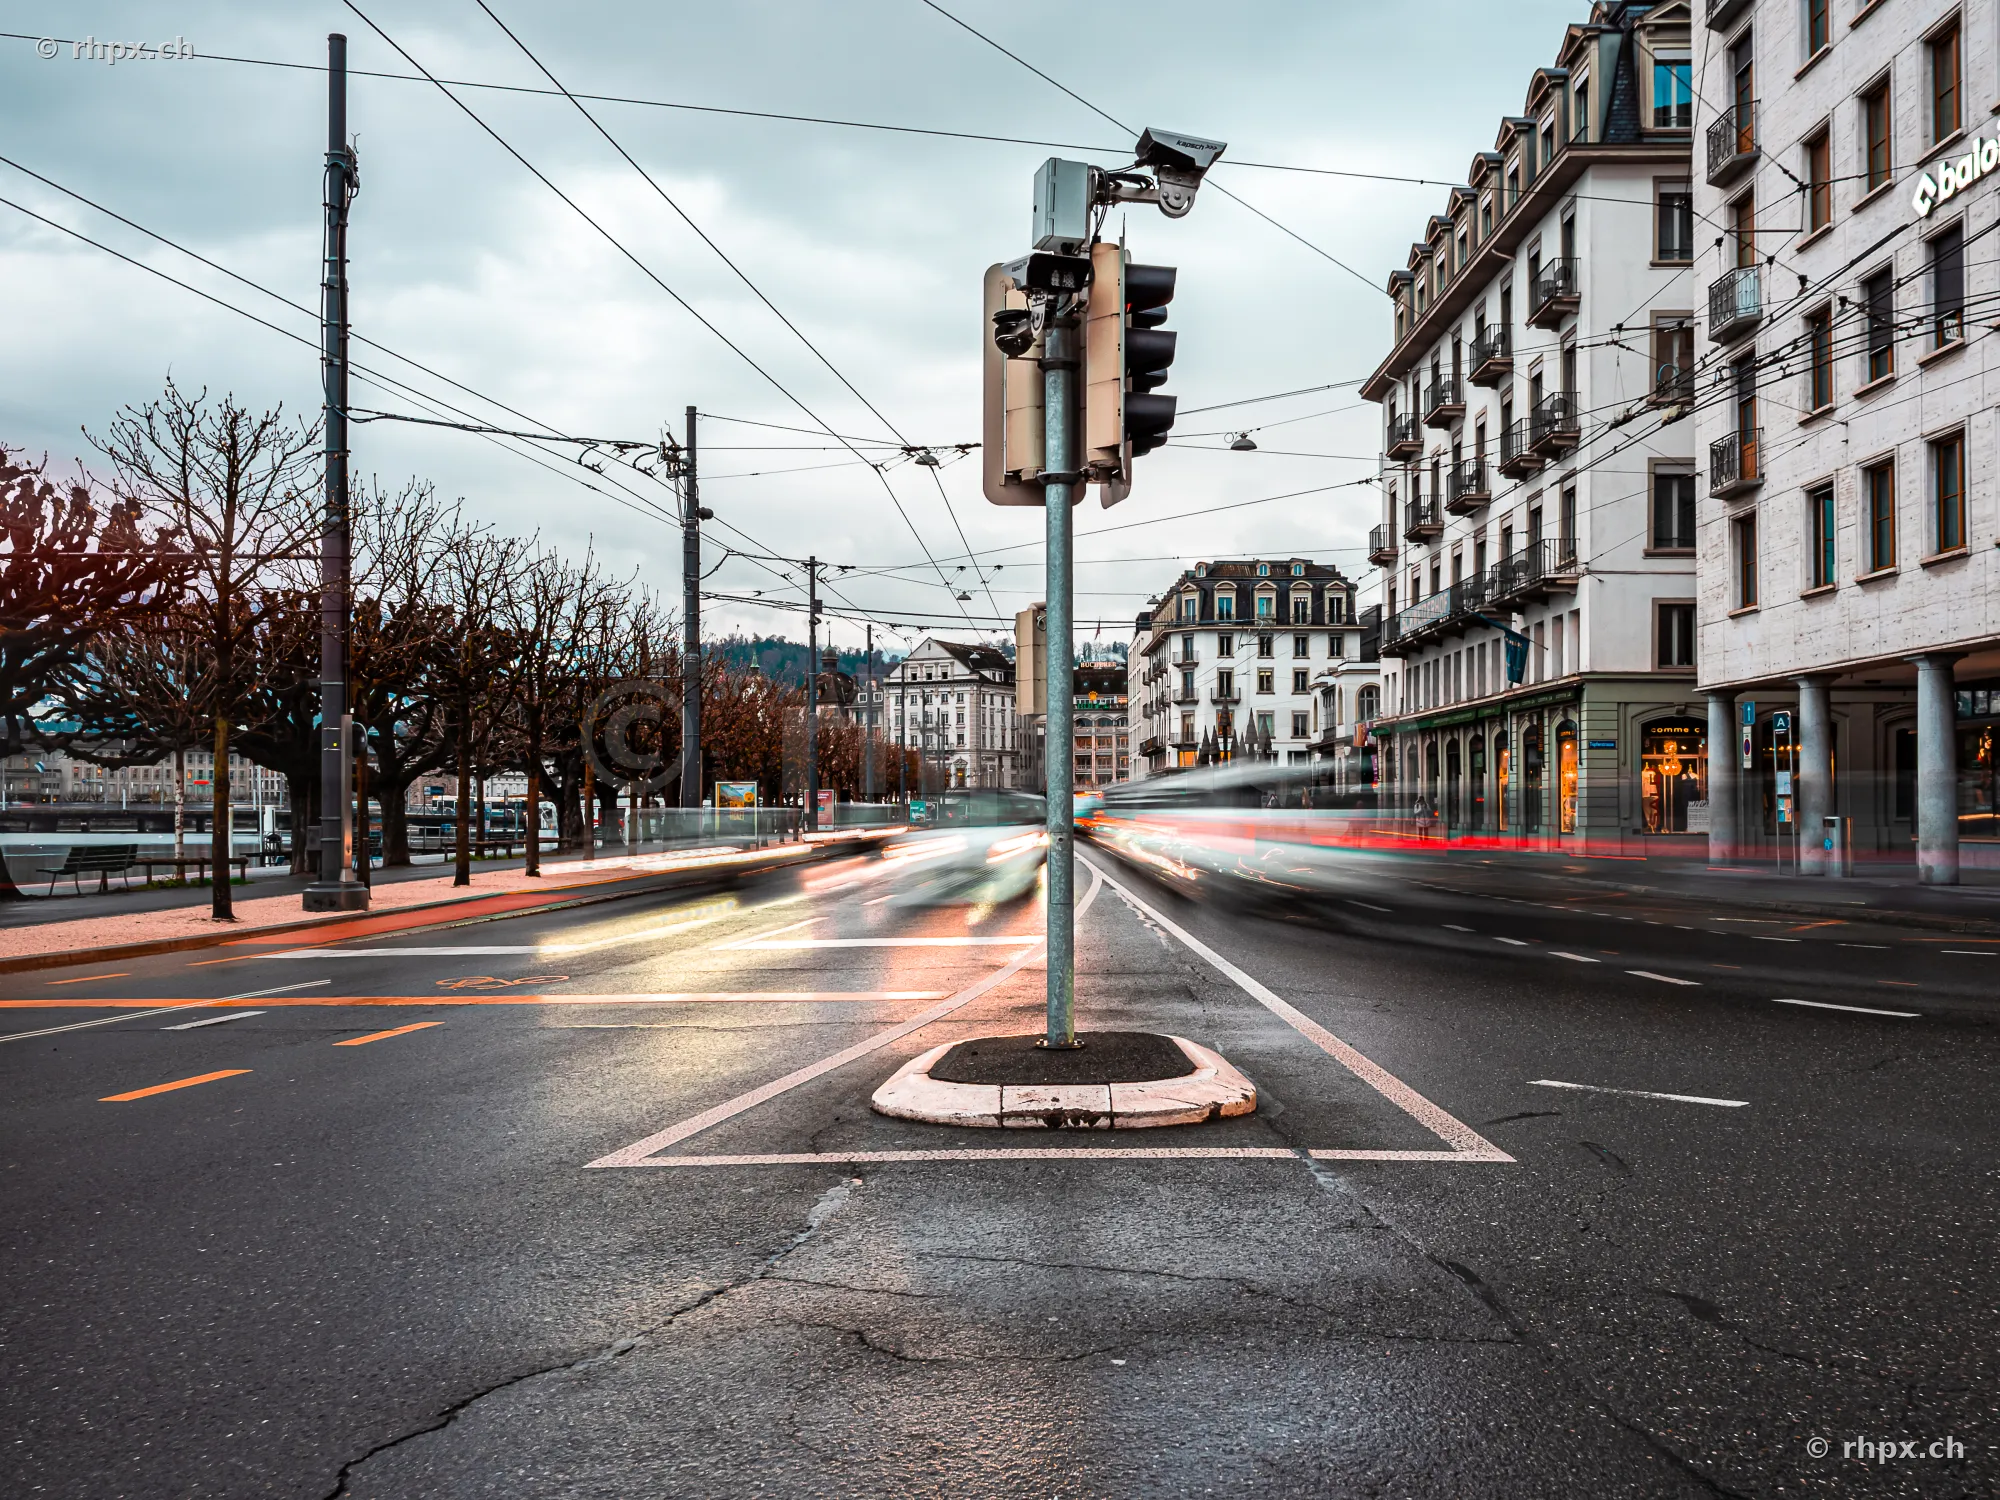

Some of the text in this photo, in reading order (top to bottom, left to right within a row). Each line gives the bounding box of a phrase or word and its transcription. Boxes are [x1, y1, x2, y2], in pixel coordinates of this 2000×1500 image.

[1176, 139, 1205, 151] kapsch
[1776, 717, 1786, 727] A
[1649, 774, 1660, 826] SALE
